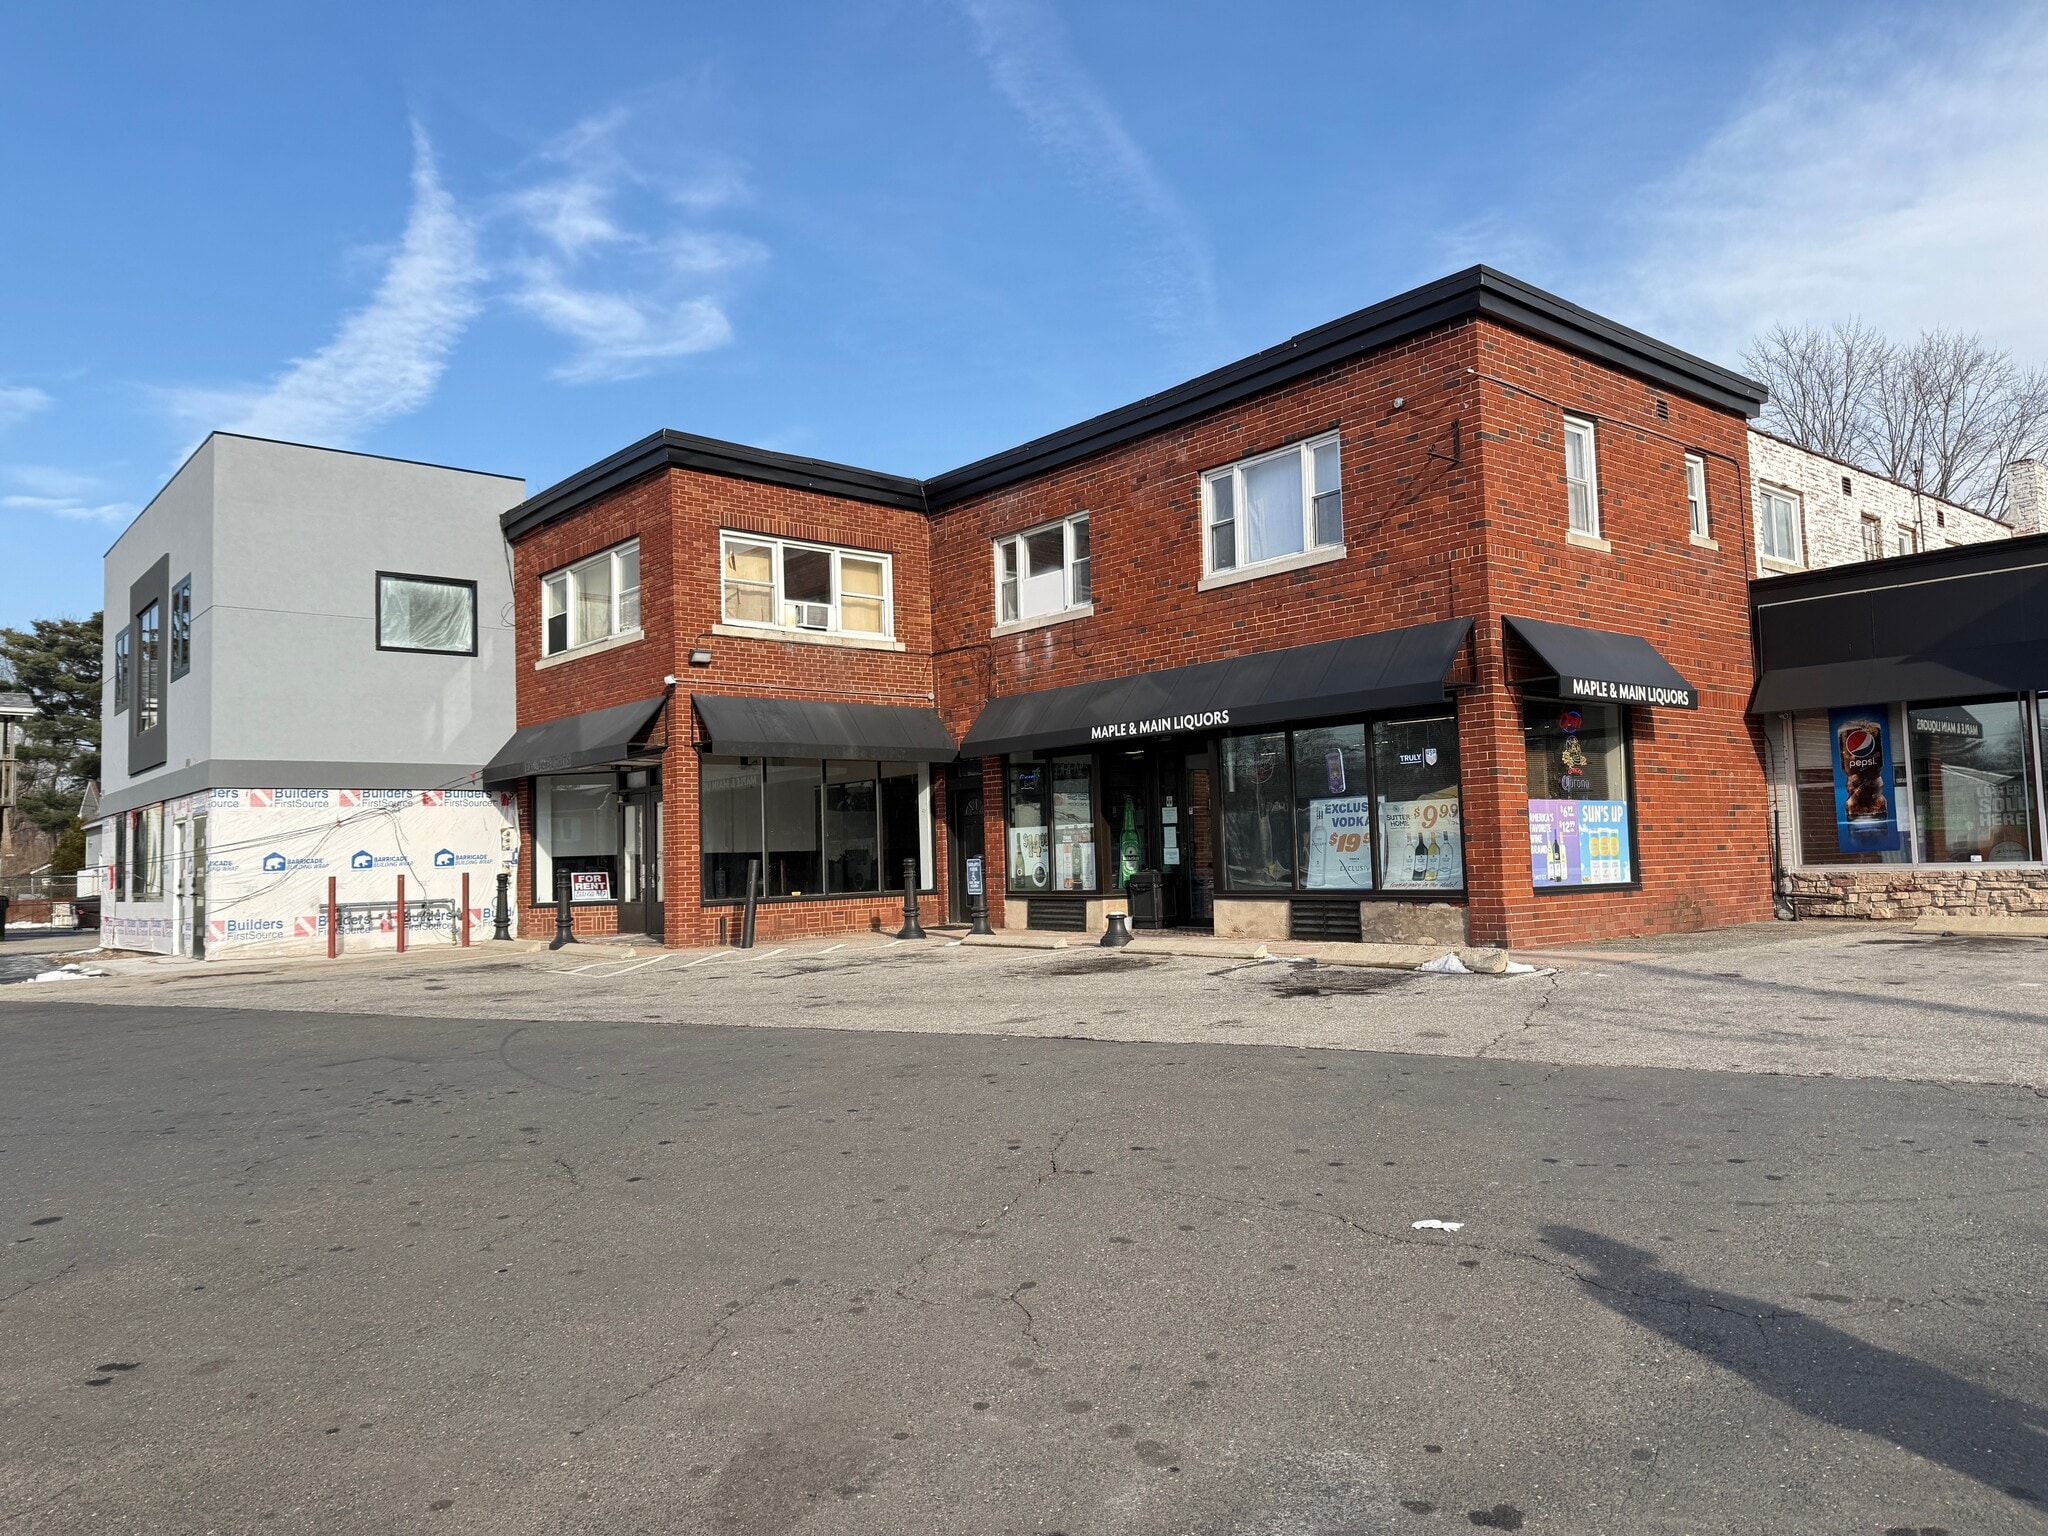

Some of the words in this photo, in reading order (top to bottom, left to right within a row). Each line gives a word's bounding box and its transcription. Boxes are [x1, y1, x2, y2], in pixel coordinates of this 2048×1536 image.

[1573, 679, 1608, 698] MAPLE
[1610, 682, 1618, 698] &
[1620, 684, 1646, 701] MAIN
[1648, 687, 1689, 706] LIQUORS
[1091, 723, 1127, 739] MAPLE
[1129, 722, 1137, 735] &
[1139, 718, 1171, 734] MAIN
[1174, 710, 1229, 730] LIQUORS
[1400, 753, 1421, 762] TRULY
[1849, 757, 1875, 769] pepsi
[275, 789, 329, 799] Builders
[362, 790, 413, 799] Builders
[444, 790, 492, 799] Builders
[1977, 784, 2024, 797] LOTTER
[274, 799, 329, 808] FirstSource
[362, 799, 413, 808] FirstSource
[444, 799, 493, 807] FirstSource
[1325, 802, 1368, 815] EXCLUS
[1582, 804, 1609, 823] SUN'S
[1611, 805, 1623, 823] UP
[1979, 812, 2026, 827] HERE
[1531, 845, 1548, 855] BRAND
[578, 875, 602, 883] FOR
[575, 882, 606, 890] RENT
[227, 919, 283, 931] Builders
[227, 930, 284, 940] FirstSource
